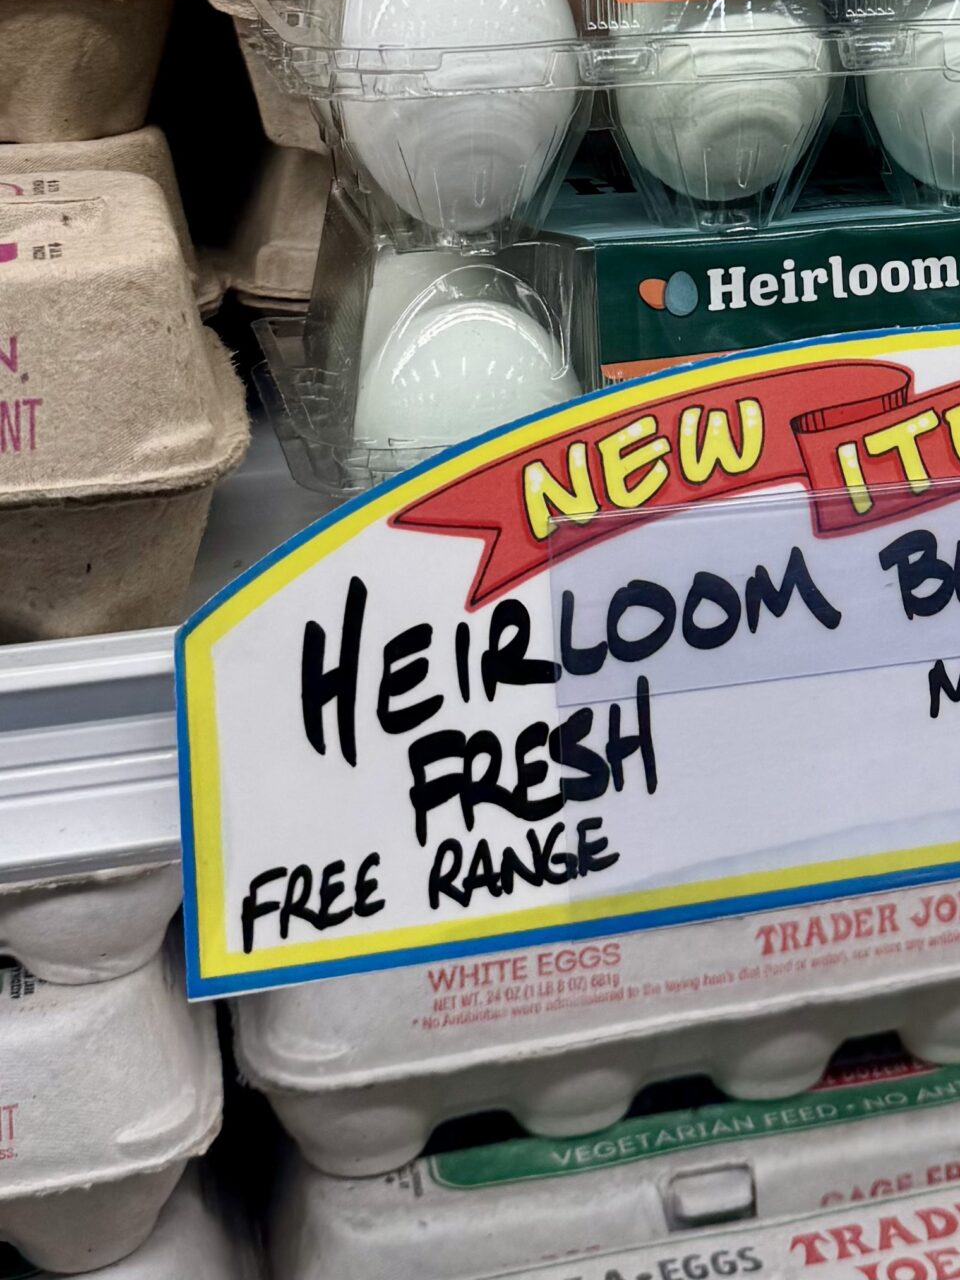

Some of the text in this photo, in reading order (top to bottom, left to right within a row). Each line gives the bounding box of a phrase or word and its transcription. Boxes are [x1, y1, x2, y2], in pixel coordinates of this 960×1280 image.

[706, 255, 959, 311] Heirloom
[523, 396, 766, 541] NEW
[300, 545, 843, 767] HEIRLOOM
[407, 675, 660, 846] FRESH
[242, 816, 620, 953] FREE RANGE
[755, 903, 900, 957] TRADER
[427, 943, 621, 993] WHITE EGGS
[433, 996, 457, 1012] NET
[551, 1114, 755, 1166] VEGETARIAN
[763, 1103, 838, 1128] FEED
[864, 1091, 908, 1111] NO
[658, 1246, 763, 1280] EGGS
